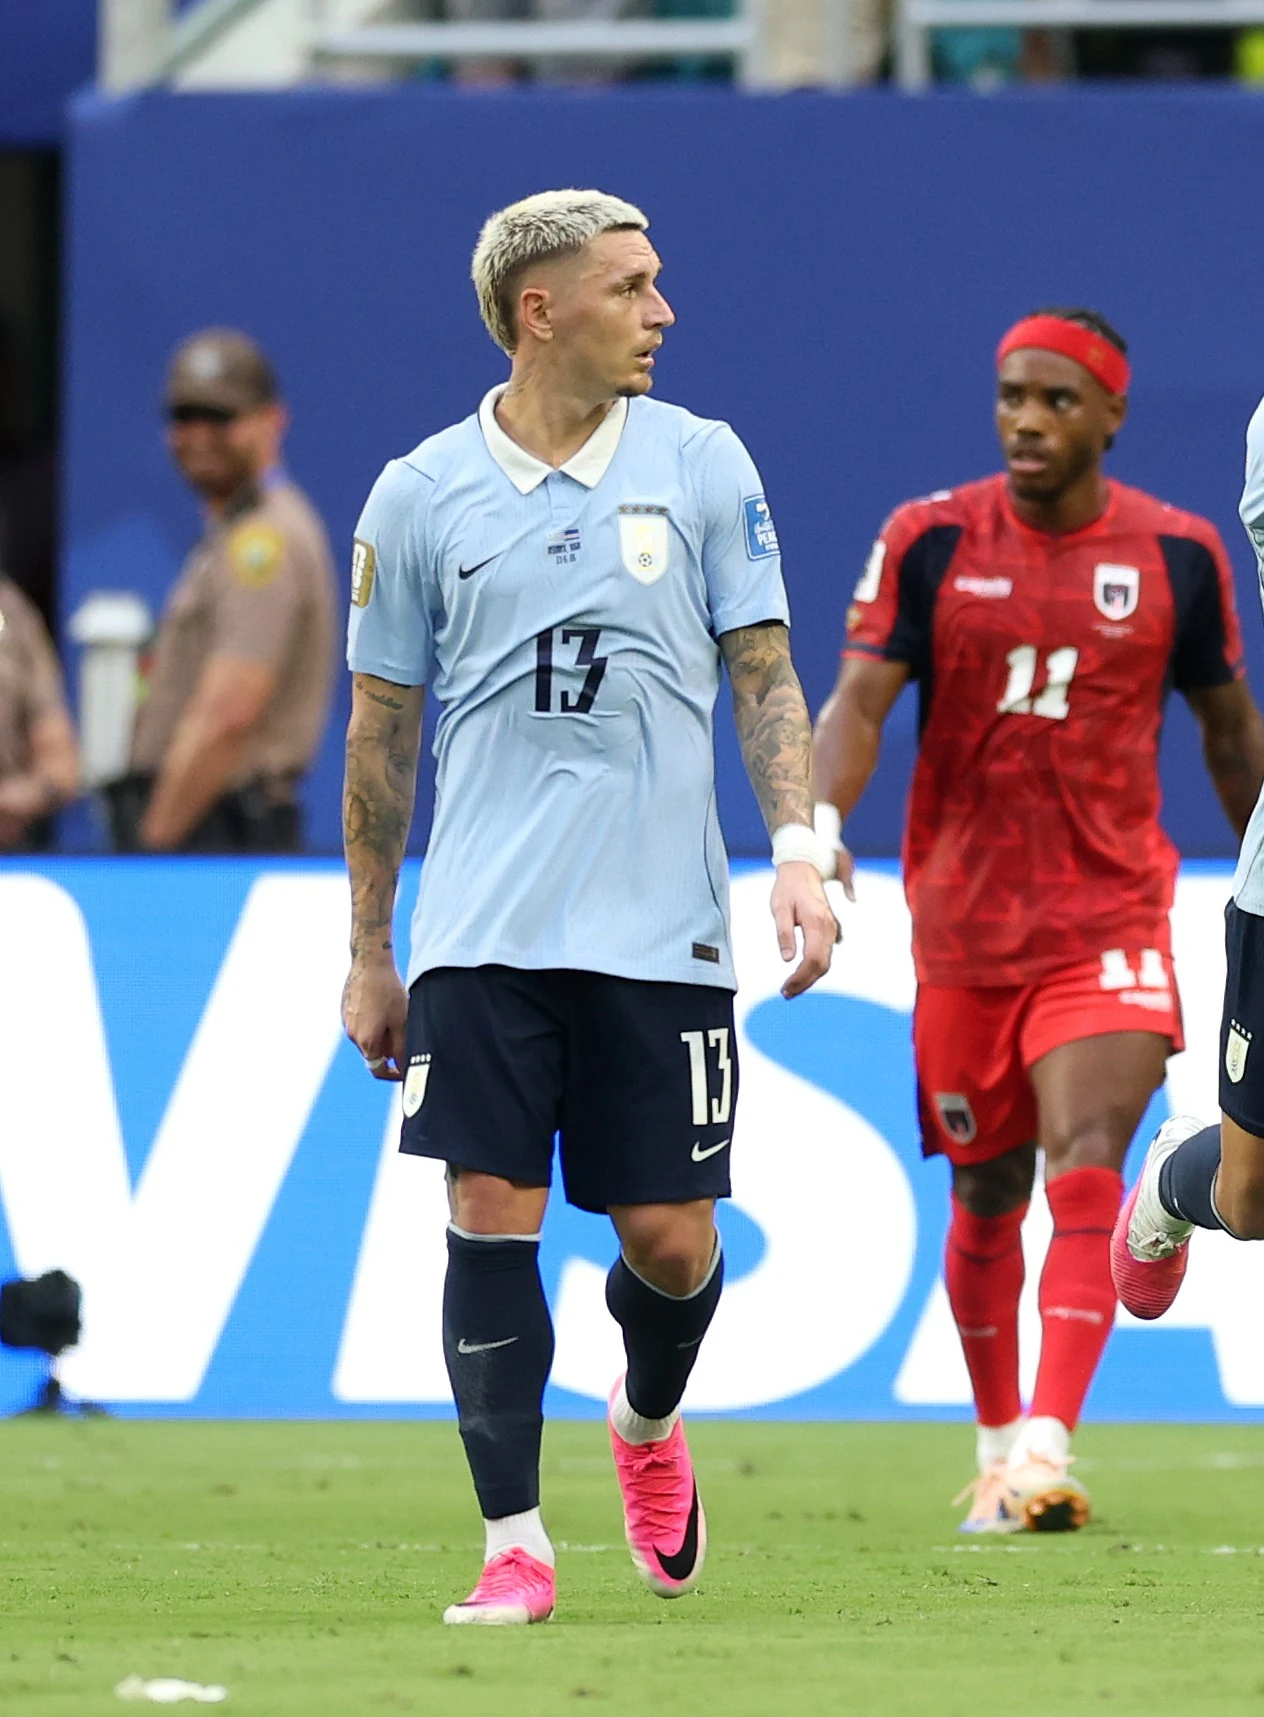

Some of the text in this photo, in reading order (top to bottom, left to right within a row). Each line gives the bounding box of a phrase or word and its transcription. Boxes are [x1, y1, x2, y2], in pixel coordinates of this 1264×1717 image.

[534, 627, 610, 714] 13
[997, 644, 1080, 720] 11
[680, 1028, 733, 1126] 13
